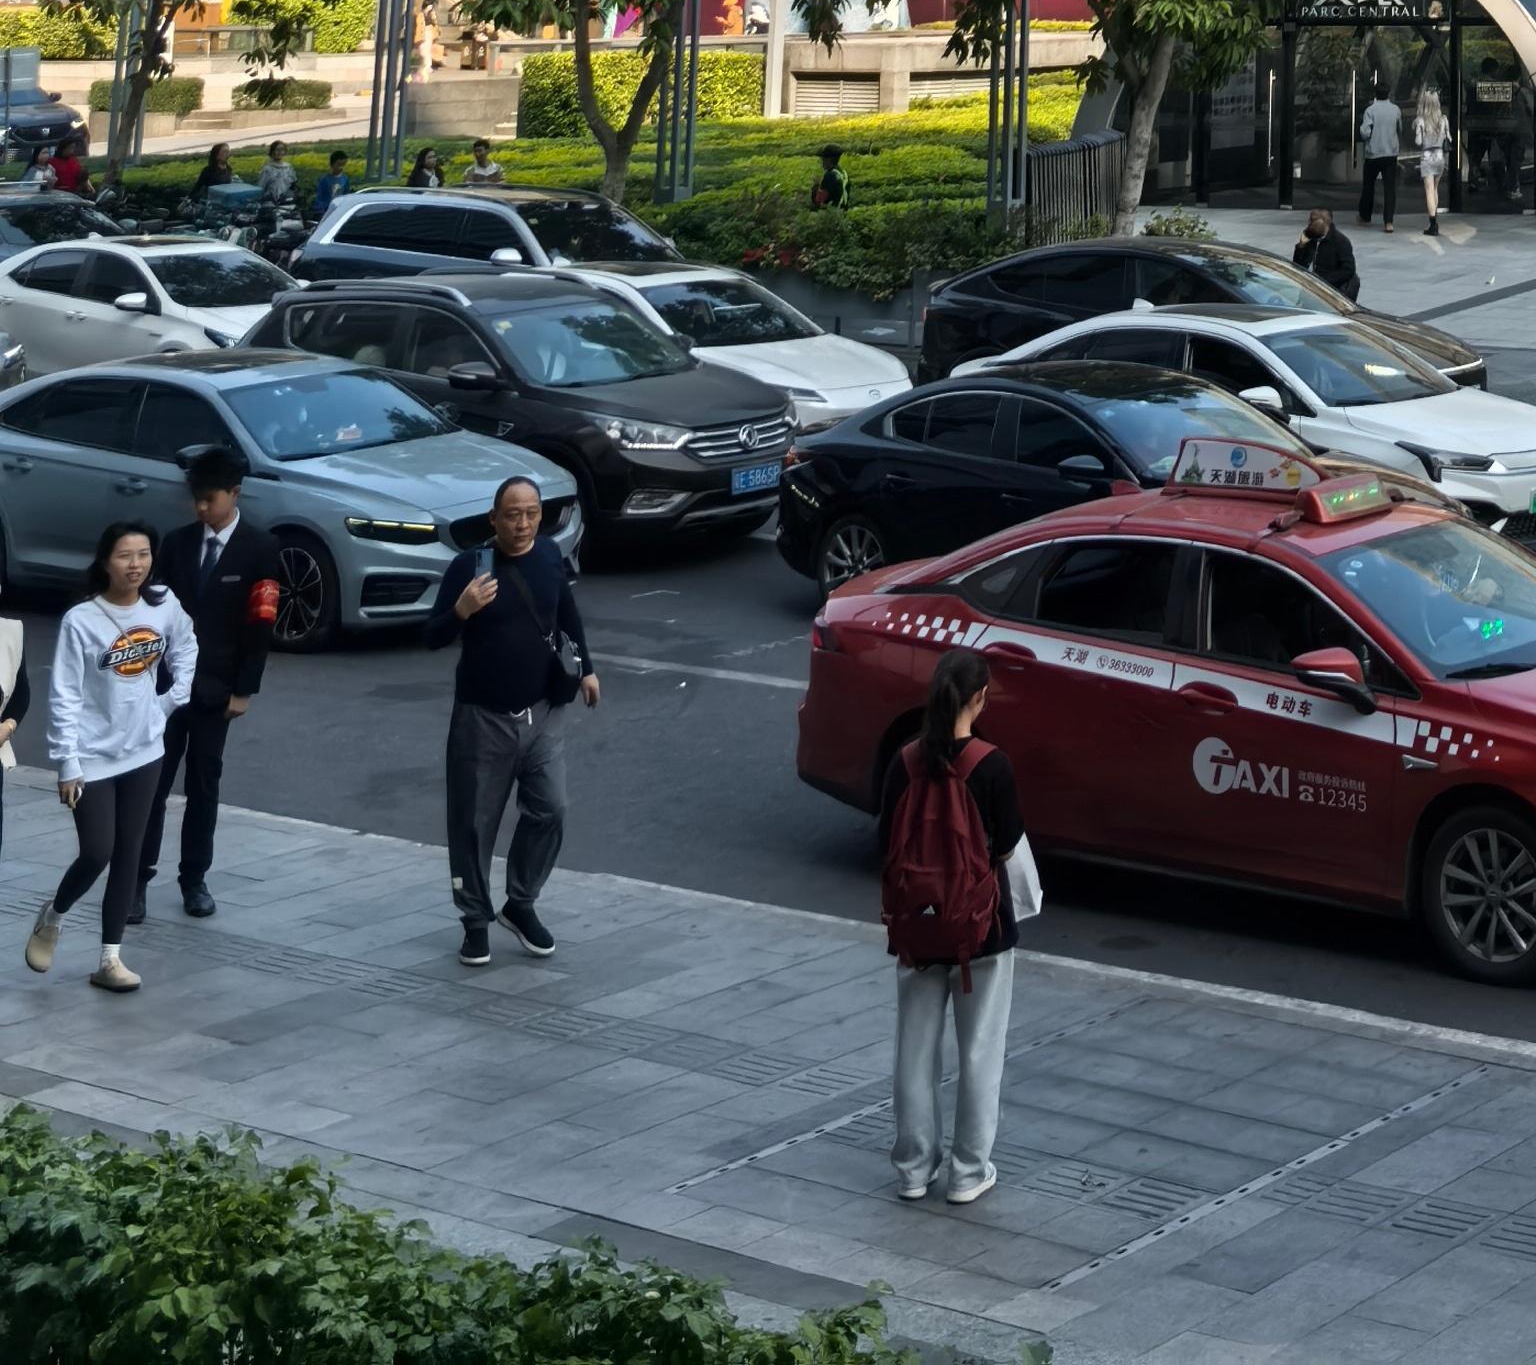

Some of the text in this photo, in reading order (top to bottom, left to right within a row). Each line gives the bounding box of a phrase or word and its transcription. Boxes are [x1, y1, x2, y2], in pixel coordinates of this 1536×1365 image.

[1302, 5, 1420, 17] PARC CENTRAL
[1211, 468, 1265, 486] 天湖旅游
[1061, 647, 1090, 665] 天湖
[1266, 691, 1313, 717] 电动车
[1193, 736, 1290, 798] TAXI
[1318, 787, 1367, 812] 12345
